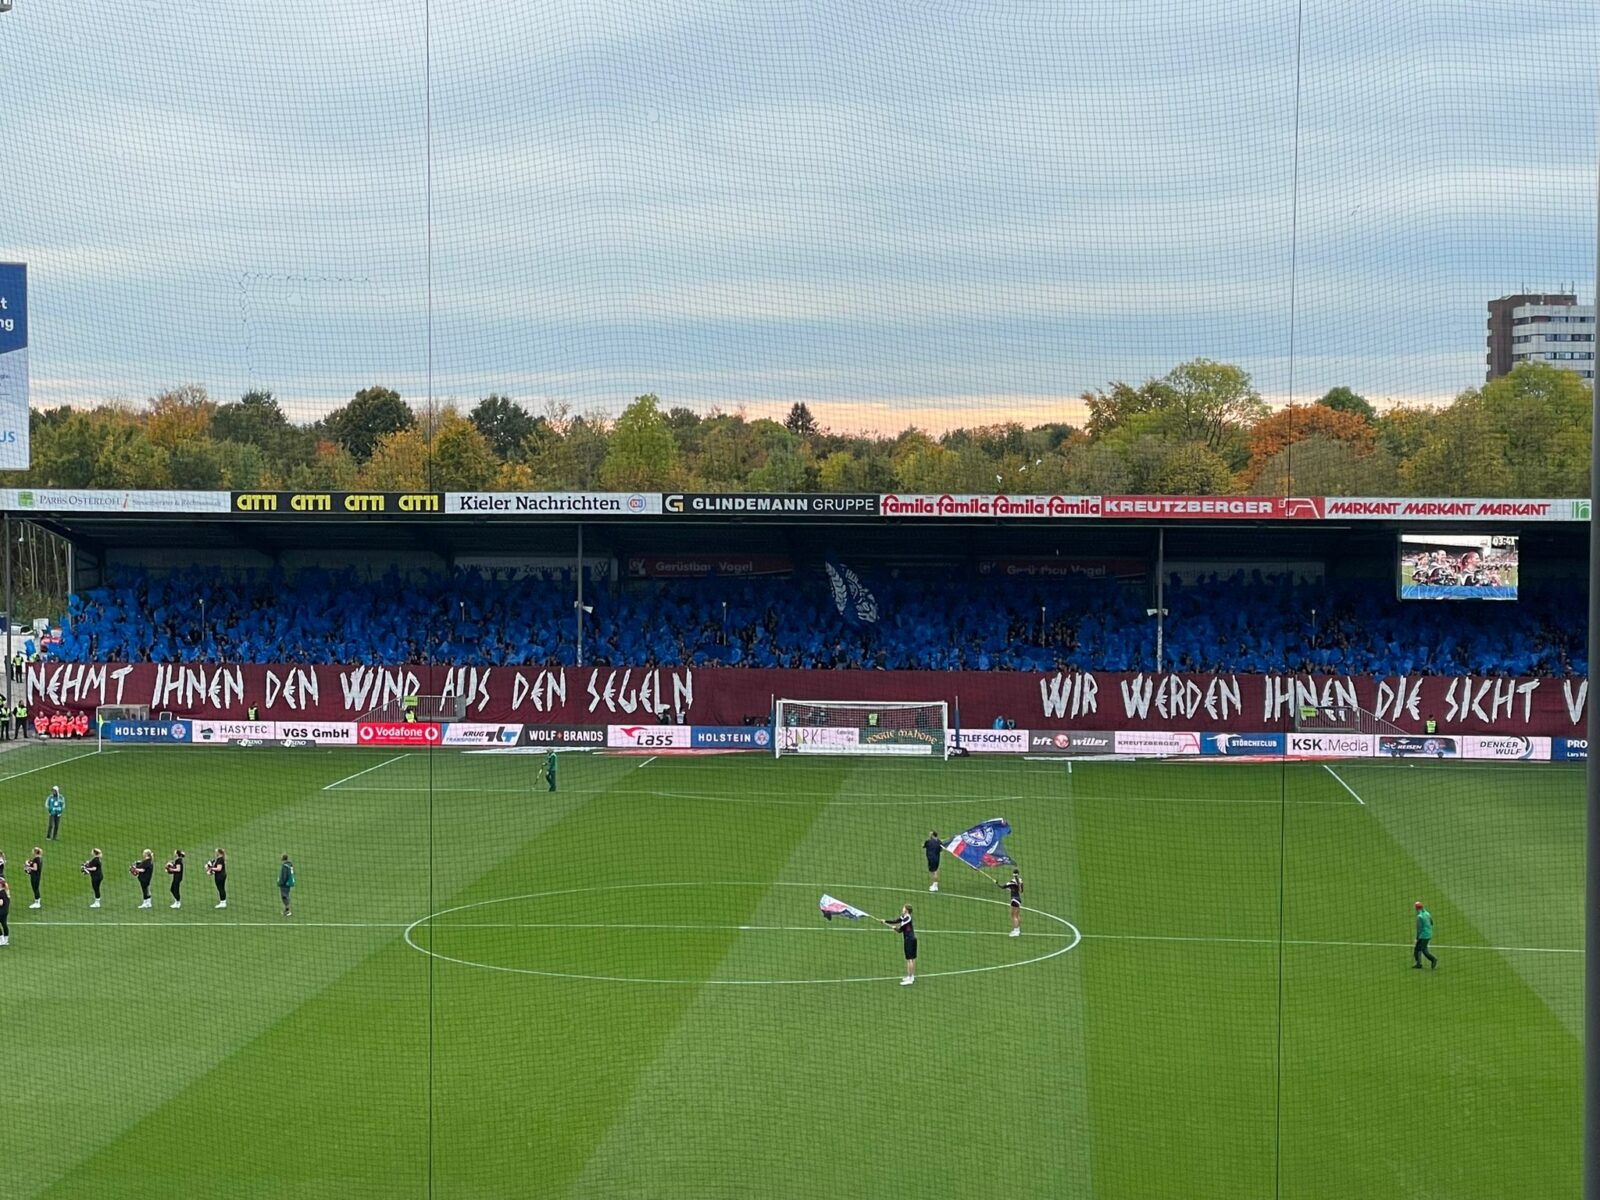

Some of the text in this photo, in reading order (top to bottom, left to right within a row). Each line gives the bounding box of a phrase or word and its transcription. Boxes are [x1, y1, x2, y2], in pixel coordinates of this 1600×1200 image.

[237, 495, 276, 510] CITTI
[291, 495, 330, 510] CITTI
[345, 495, 384, 511] CITTI
[398, 495, 438, 511] CITTI
[460, 496, 511, 510] Kieler
[516, 496, 620, 510] Nachrichten
[692, 498, 874, 511] GLINDEMANN GRUPPE
[881, 495, 934, 516] famila
[936, 495, 989, 516] famila
[991, 496, 1045, 516] famila
[1047, 496, 1100, 517] famila
[1104, 500, 1272, 513] KREUTZBERGER
[1328, 502, 1401, 514] MARKANT
[1402, 503, 1475, 515] MARKANT
[1476, 504, 1551, 516] MARKANT
[27, 664, 693, 715] NEHMT IHNEN DEN WIND AUS DEN SEGELN
[1040, 672, 1098, 719] WIR
[1121, 672, 1241, 720] WERDEN
[1264, 675, 1359, 722] IHNEN
[1375, 675, 1423, 722] DIE
[1445, 677, 1540, 724] SICHT
[115, 727, 167, 736] HOLSTEIN
[220, 725, 268, 735] HASYTEC
[283, 728, 349, 738] VGS GmbH
[376, 727, 422, 737] Vodafone
[529, 731, 556, 741] WOLF
[563, 731, 604, 742] BRANDS
[698, 733, 750, 743] HOLSTEIN
[951, 735, 1022, 743] DETLEF SCHOOF
[1032, 736, 1053, 746] bft
[1072, 738, 1109, 746] willer
